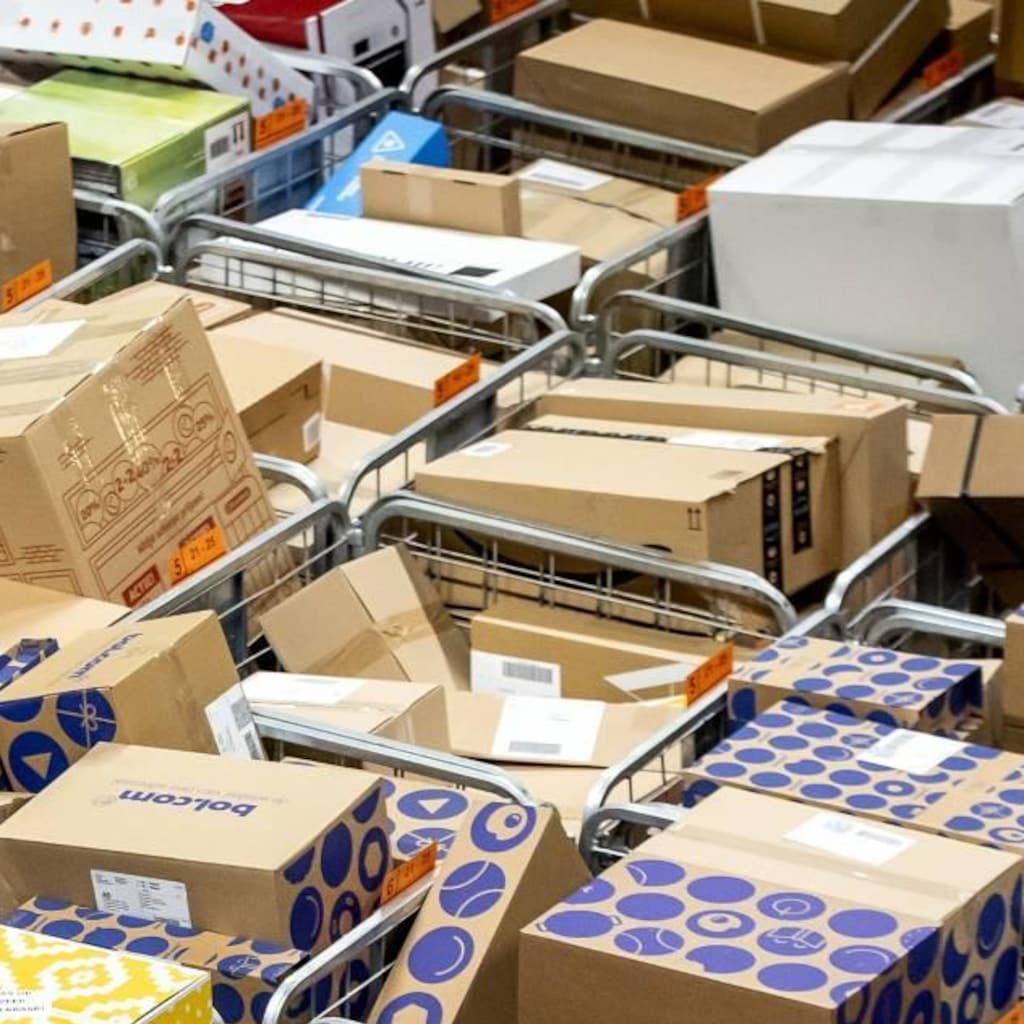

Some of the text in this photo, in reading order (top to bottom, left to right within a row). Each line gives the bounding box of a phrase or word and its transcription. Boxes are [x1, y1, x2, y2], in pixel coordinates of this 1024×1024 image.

[175, 558, 182, 577] 5
[118, 789, 258, 817] bol.com
[387, 880, 394, 897] 6
